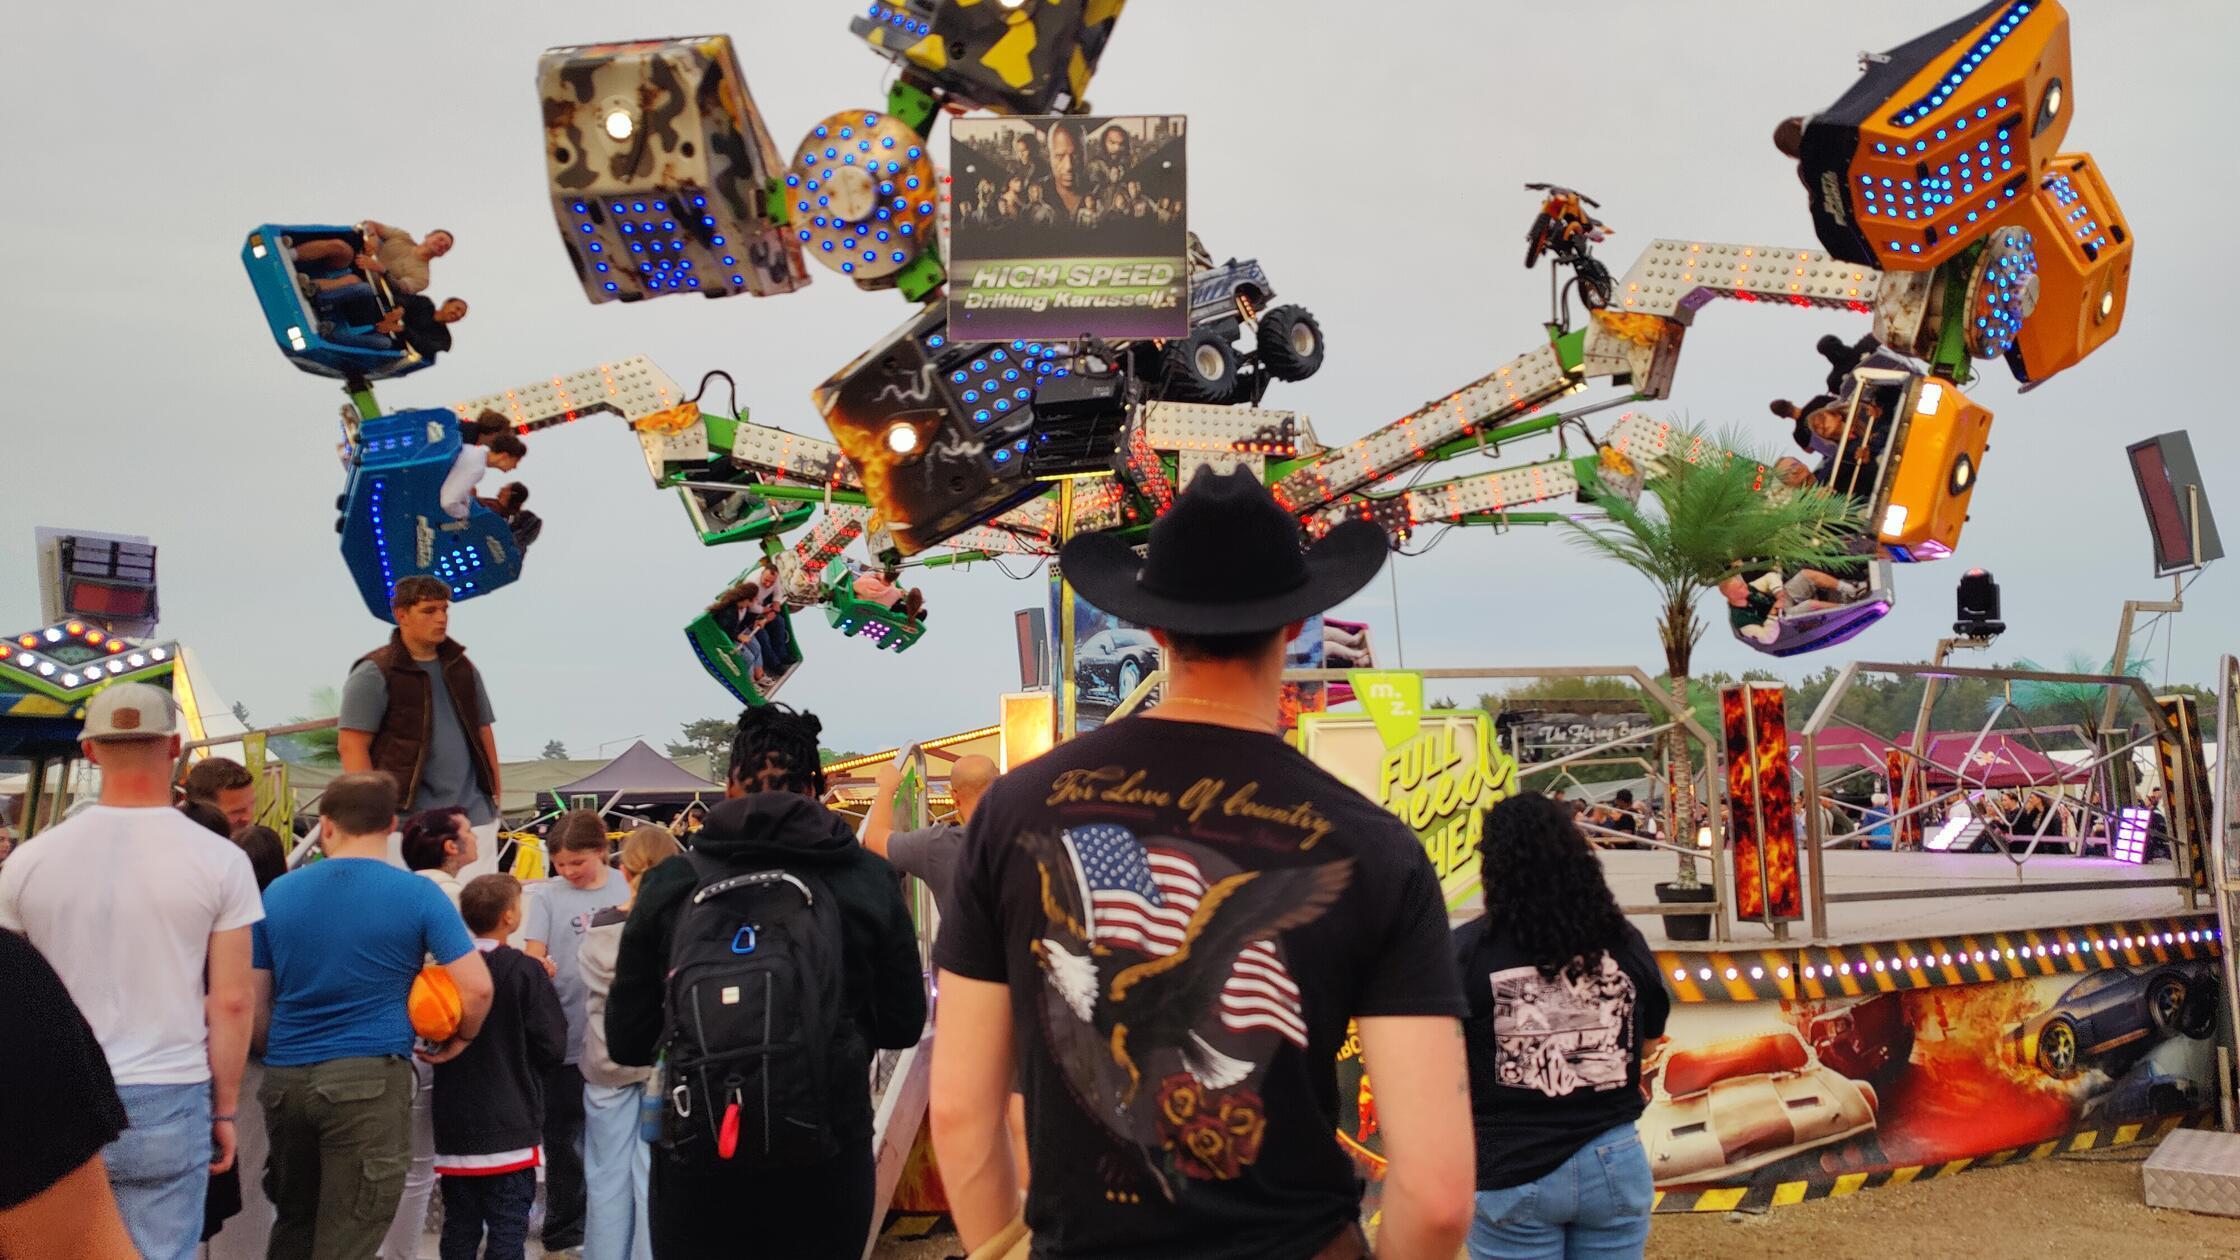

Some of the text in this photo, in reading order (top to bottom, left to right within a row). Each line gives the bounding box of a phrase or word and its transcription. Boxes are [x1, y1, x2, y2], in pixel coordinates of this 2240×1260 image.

[964, 292, 1048, 312] Drifting
[972, 264, 1174, 288] HIGH SPEED
[1380, 717, 1461, 803] FULL
[1102, 769, 1173, 807] Love
[1223, 781, 1335, 851] Country
